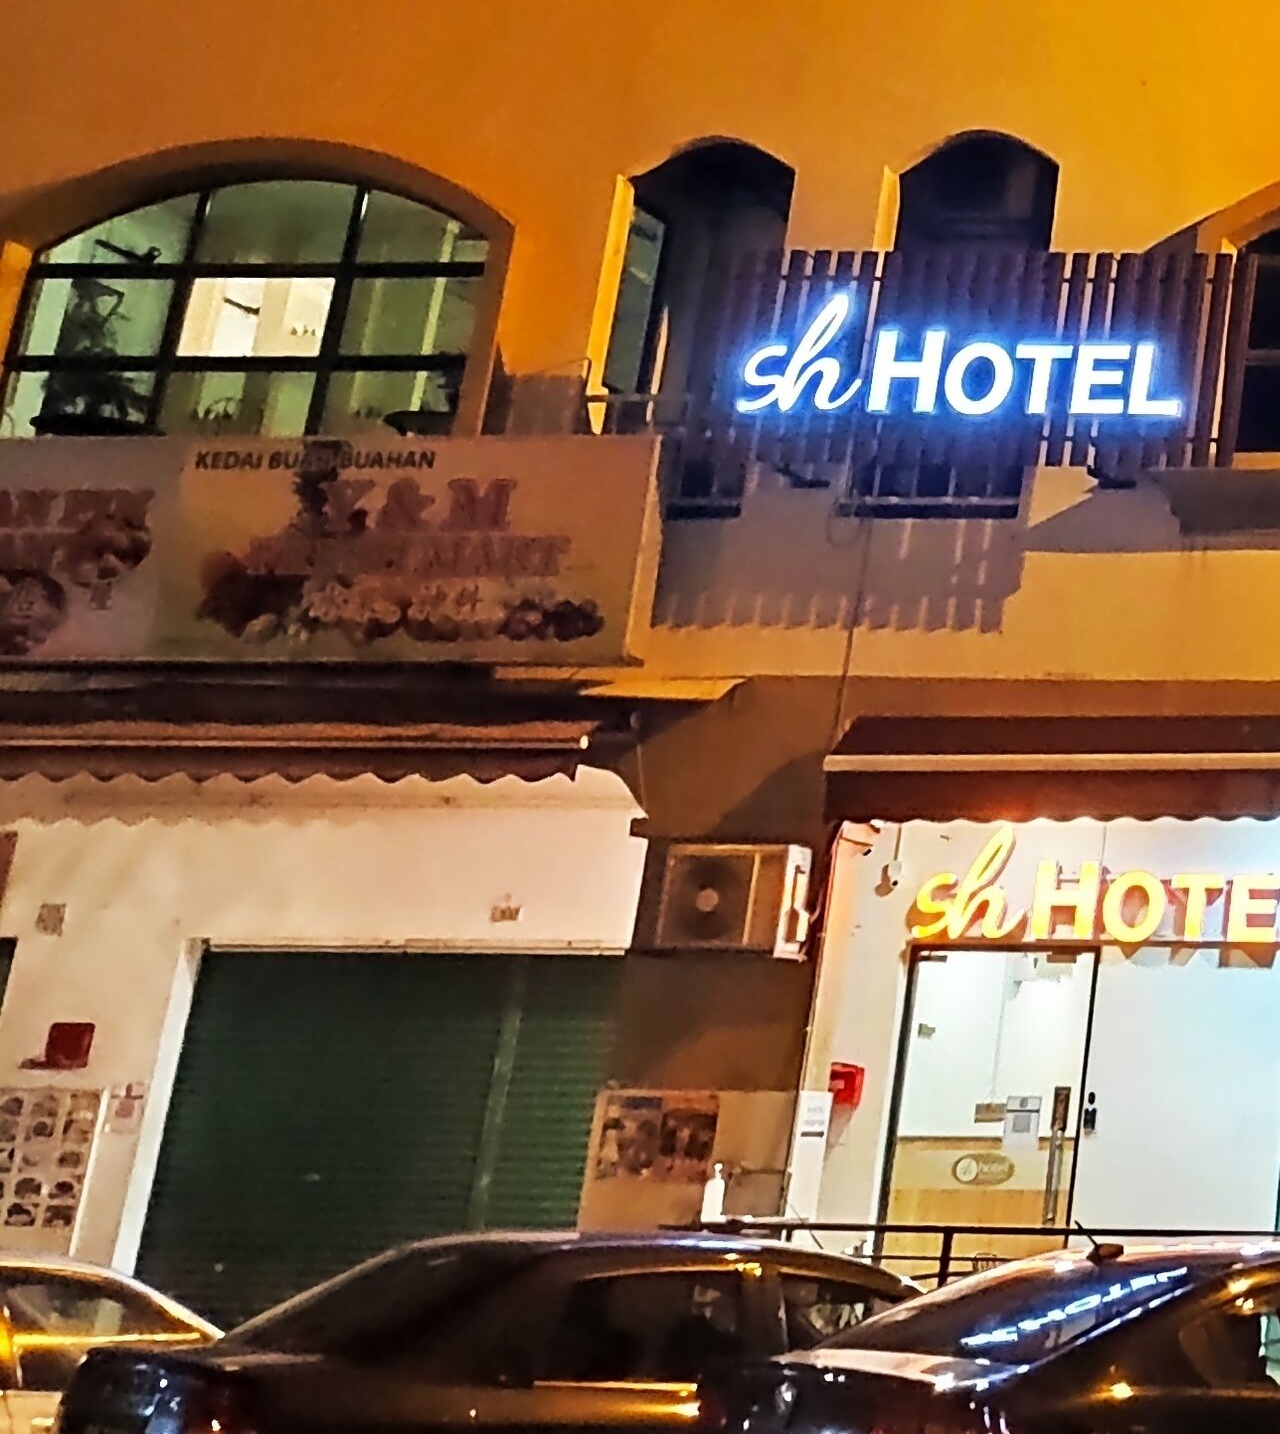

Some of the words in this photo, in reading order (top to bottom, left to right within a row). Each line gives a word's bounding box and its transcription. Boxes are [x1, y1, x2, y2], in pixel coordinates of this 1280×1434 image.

[736, 293, 861, 412] sh
[866, 330, 1182, 416] HOTEL
[195, 451, 262, 470] KEDAI
[912, 826, 1026, 940] sh
